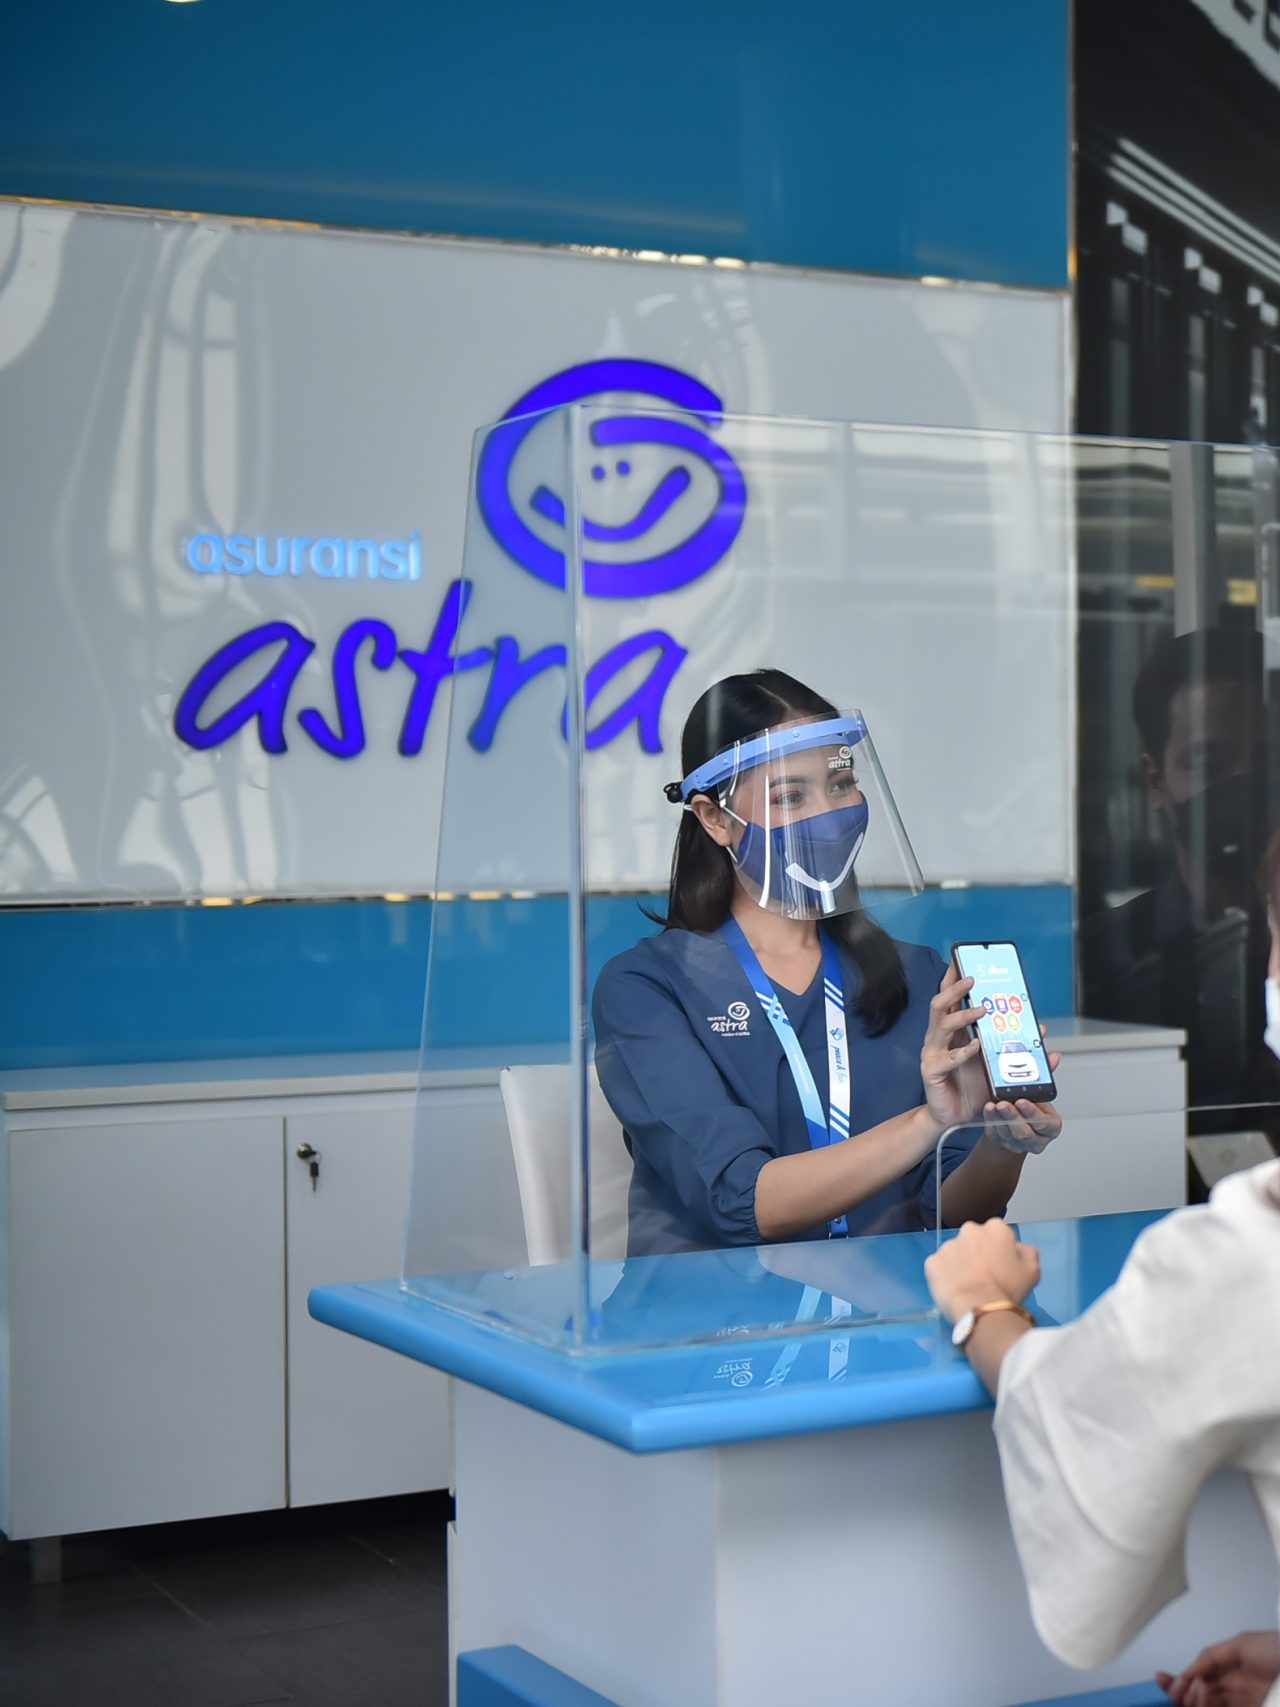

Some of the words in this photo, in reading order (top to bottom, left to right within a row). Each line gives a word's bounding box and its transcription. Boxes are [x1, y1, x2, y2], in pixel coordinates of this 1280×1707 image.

[186, 529, 422, 581] asuransi
[174, 579, 688, 757] astra
[710, 1018, 748, 1032] astra
